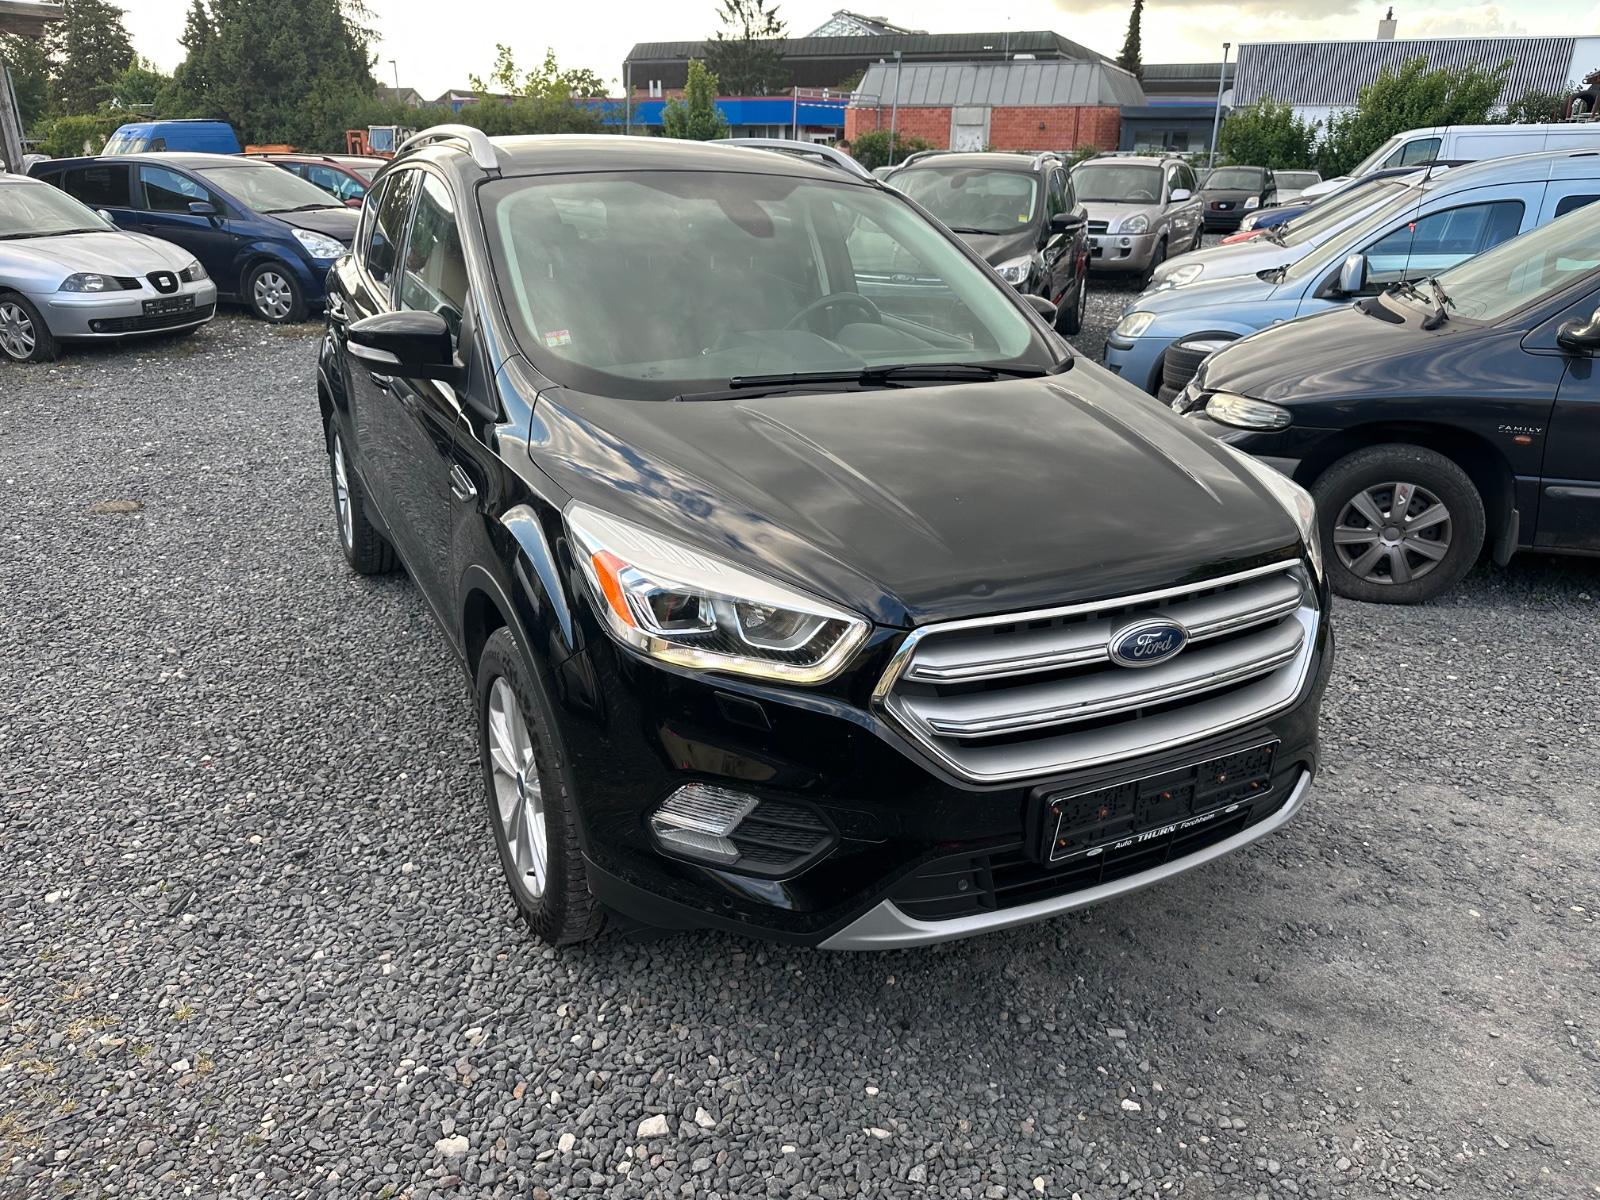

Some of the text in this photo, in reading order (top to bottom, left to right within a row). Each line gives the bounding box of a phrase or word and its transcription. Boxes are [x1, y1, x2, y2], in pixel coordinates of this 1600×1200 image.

[1498, 424, 1541, 433] FAMILY
[1133, 632, 1172, 657] Ford
[1114, 840, 1132, 850] Auto
[1138, 825, 1176, 842] THURN
